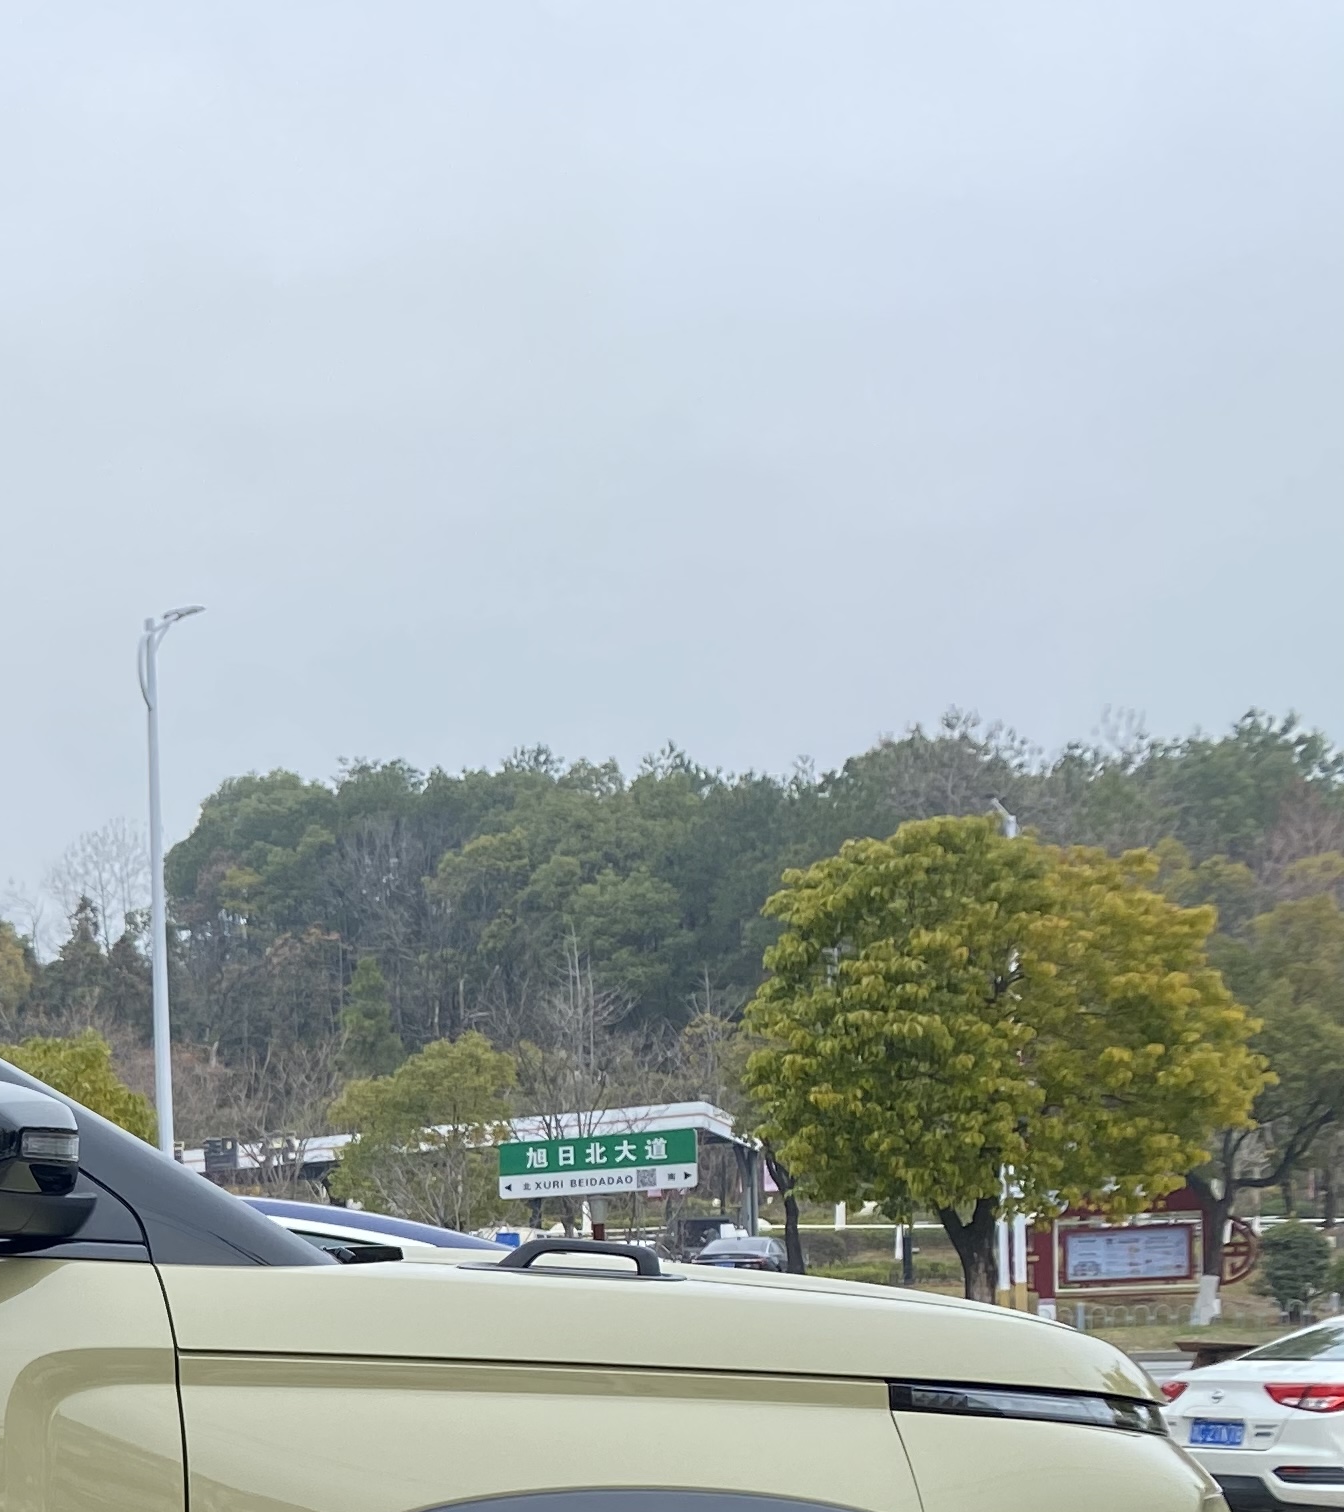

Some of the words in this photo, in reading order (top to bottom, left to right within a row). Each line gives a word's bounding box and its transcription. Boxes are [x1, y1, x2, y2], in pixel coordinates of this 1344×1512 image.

[525, 1137, 668, 1169] 旭日北大道
[534, 1180, 565, 1191] XURI
[570, 1174, 634, 1189] BEIDADAO
